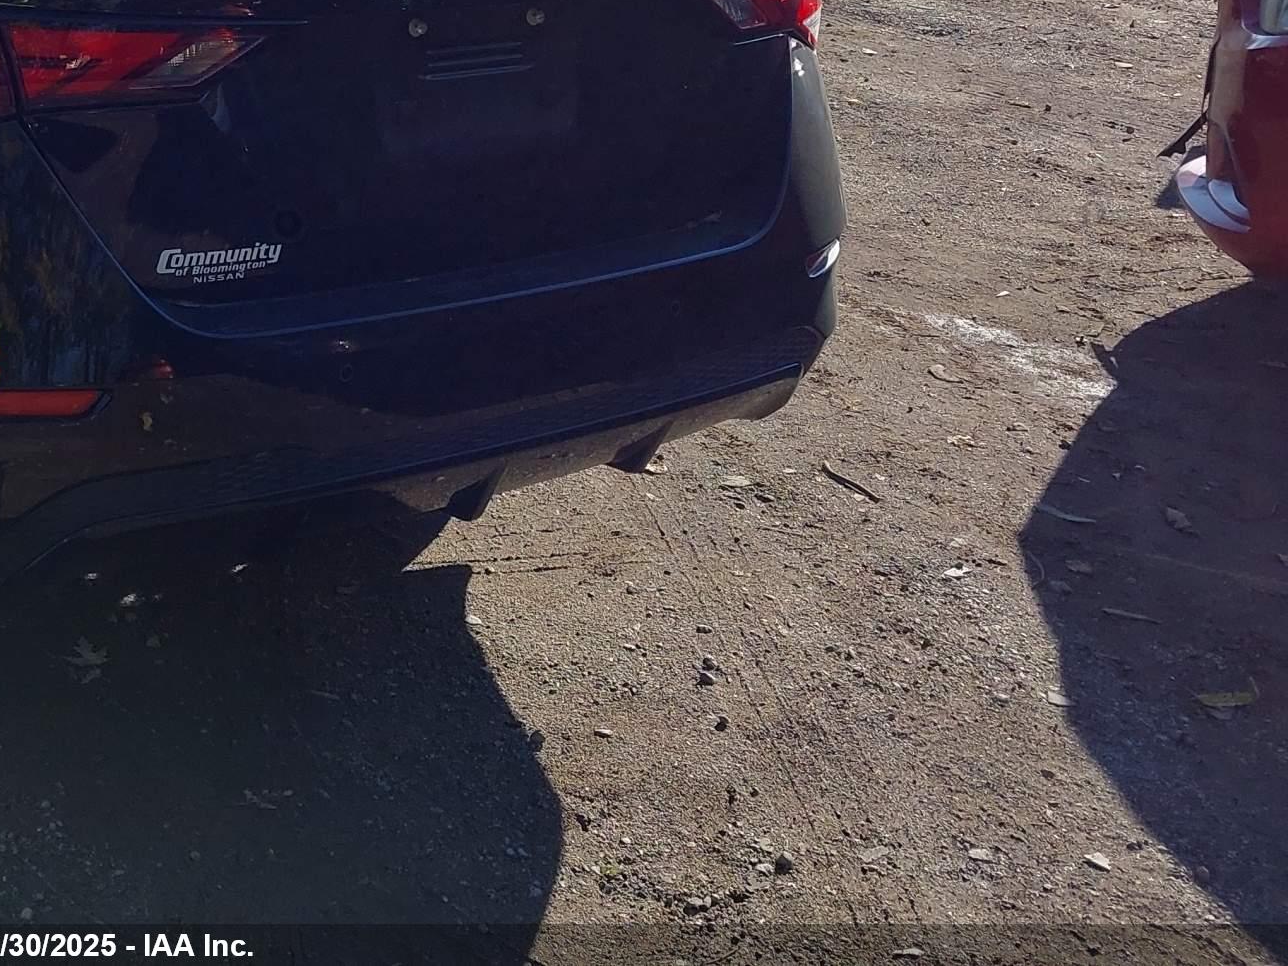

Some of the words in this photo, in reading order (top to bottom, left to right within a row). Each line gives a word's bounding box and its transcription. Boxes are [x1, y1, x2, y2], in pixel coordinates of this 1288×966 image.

[156, 242, 282, 274] Community
[175, 266, 190, 276] of
[192, 261, 266, 275] Bloomington
[193, 272, 245, 283] NISSAN
